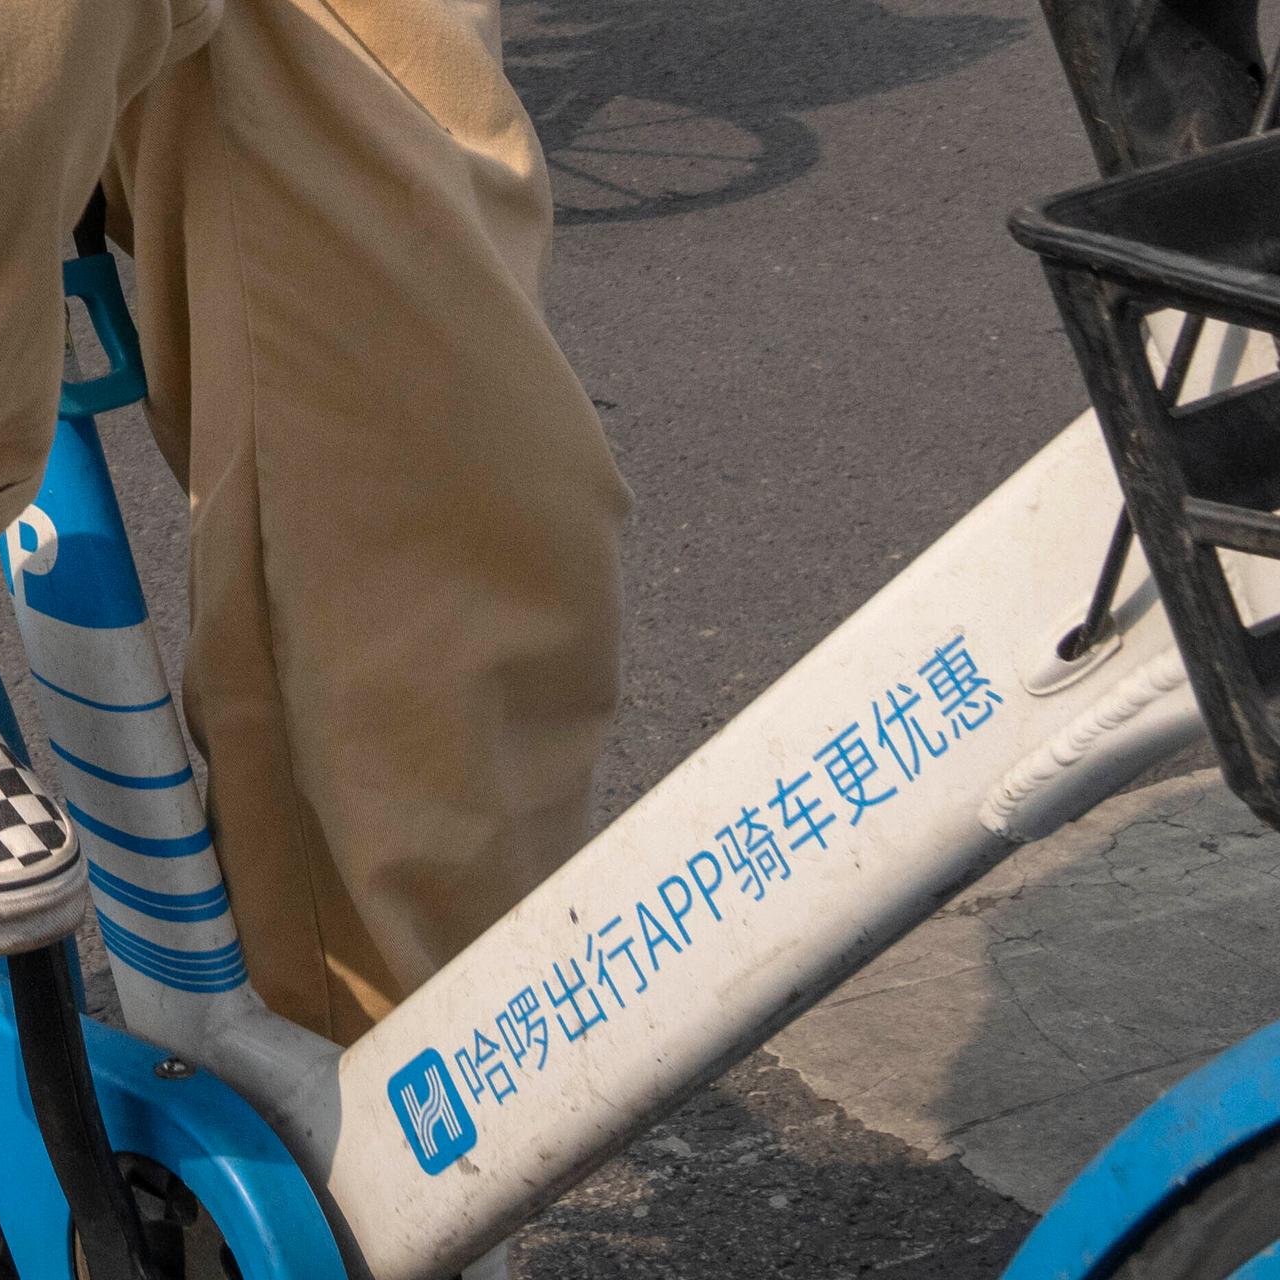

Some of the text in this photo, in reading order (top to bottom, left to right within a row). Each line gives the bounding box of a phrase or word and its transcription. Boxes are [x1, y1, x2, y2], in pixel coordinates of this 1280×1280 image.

[454, 635, 1005, 1108] 哈啰出行APP骑车更优惠
